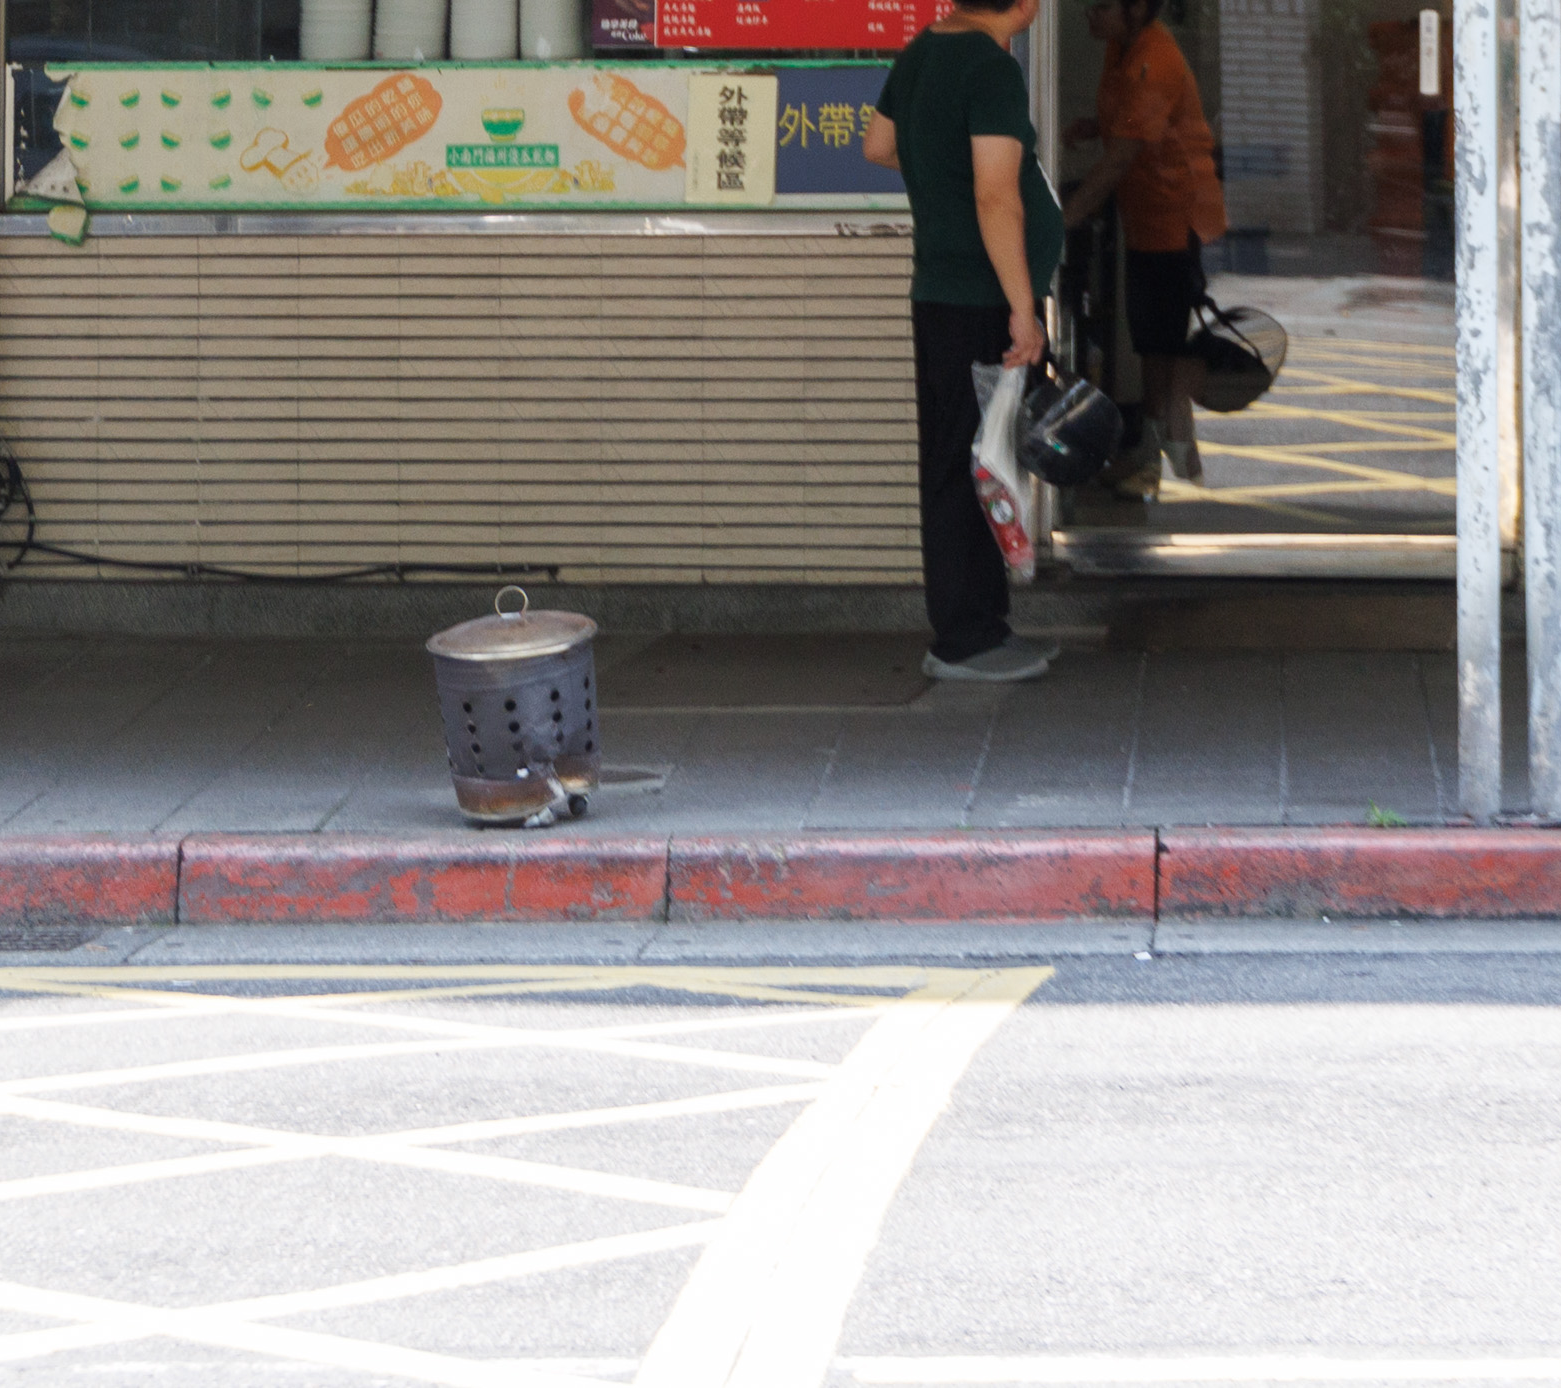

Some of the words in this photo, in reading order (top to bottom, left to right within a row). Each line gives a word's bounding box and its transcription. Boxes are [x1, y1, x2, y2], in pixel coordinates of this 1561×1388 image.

[716, 85, 749, 192] 外帶等候區
